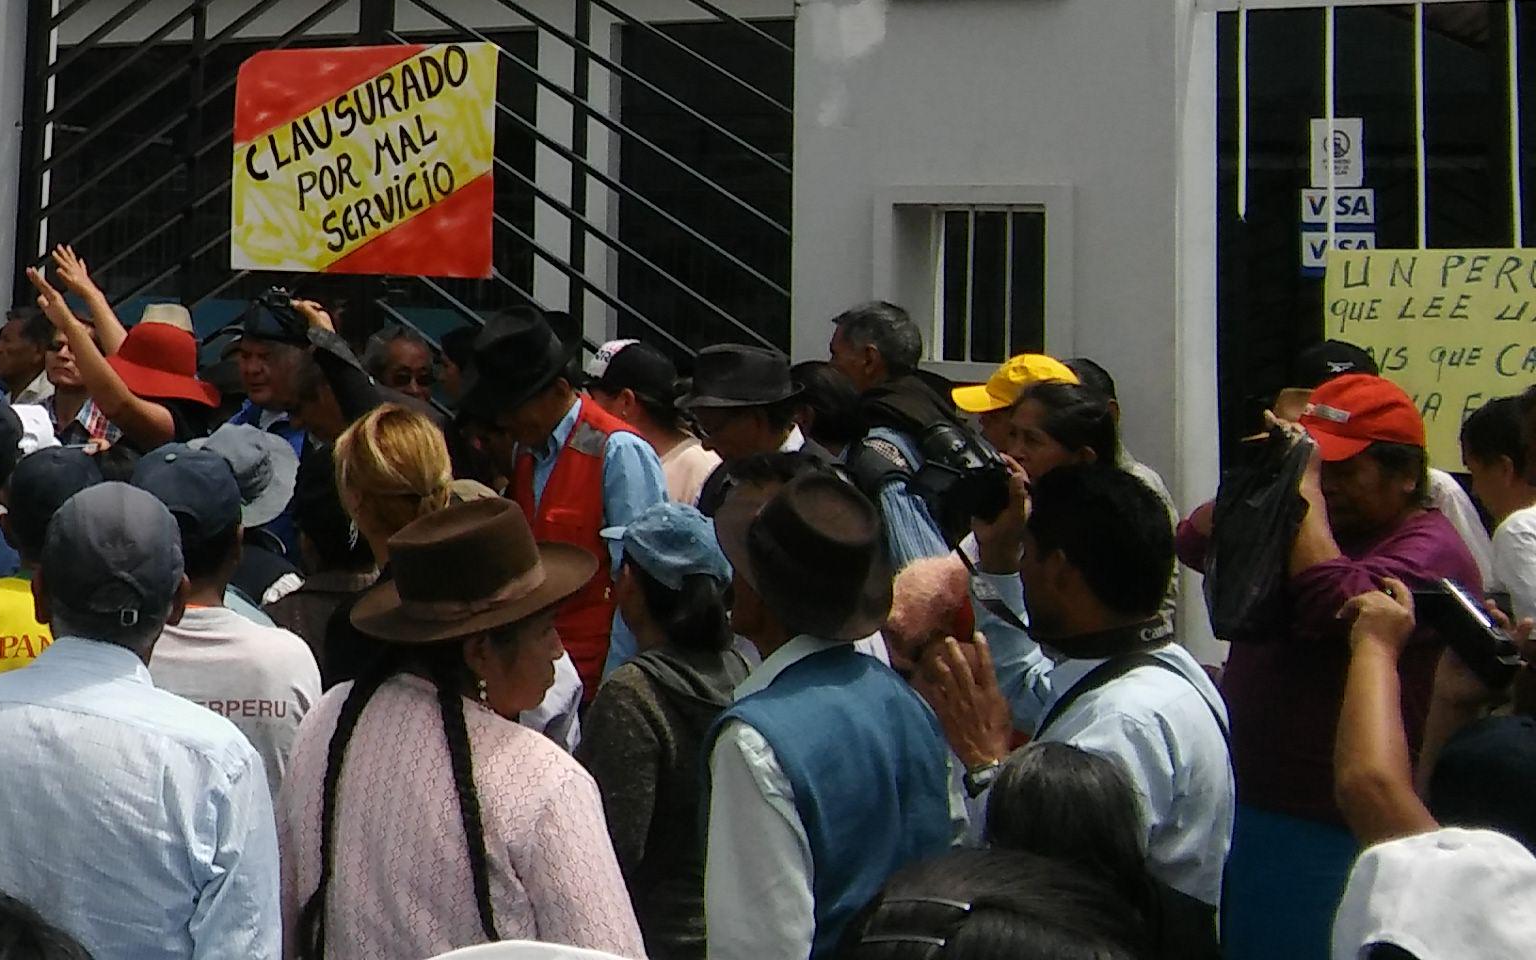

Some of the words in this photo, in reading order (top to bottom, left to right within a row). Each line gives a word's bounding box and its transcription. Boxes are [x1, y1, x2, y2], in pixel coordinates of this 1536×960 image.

[245, 45, 469, 182] CLAUSURADO
[297, 152, 362, 212] POR
[374, 114, 439, 177] MAL
[1307, 195, 1371, 216] VSA
[1343, 255, 1419, 289] UN
[1440, 254, 1536, 294] PER
[1397, 294, 1472, 320] LEE
[1494, 301, 1536, 322] U
[192, 699, 287, 719] RPERU
